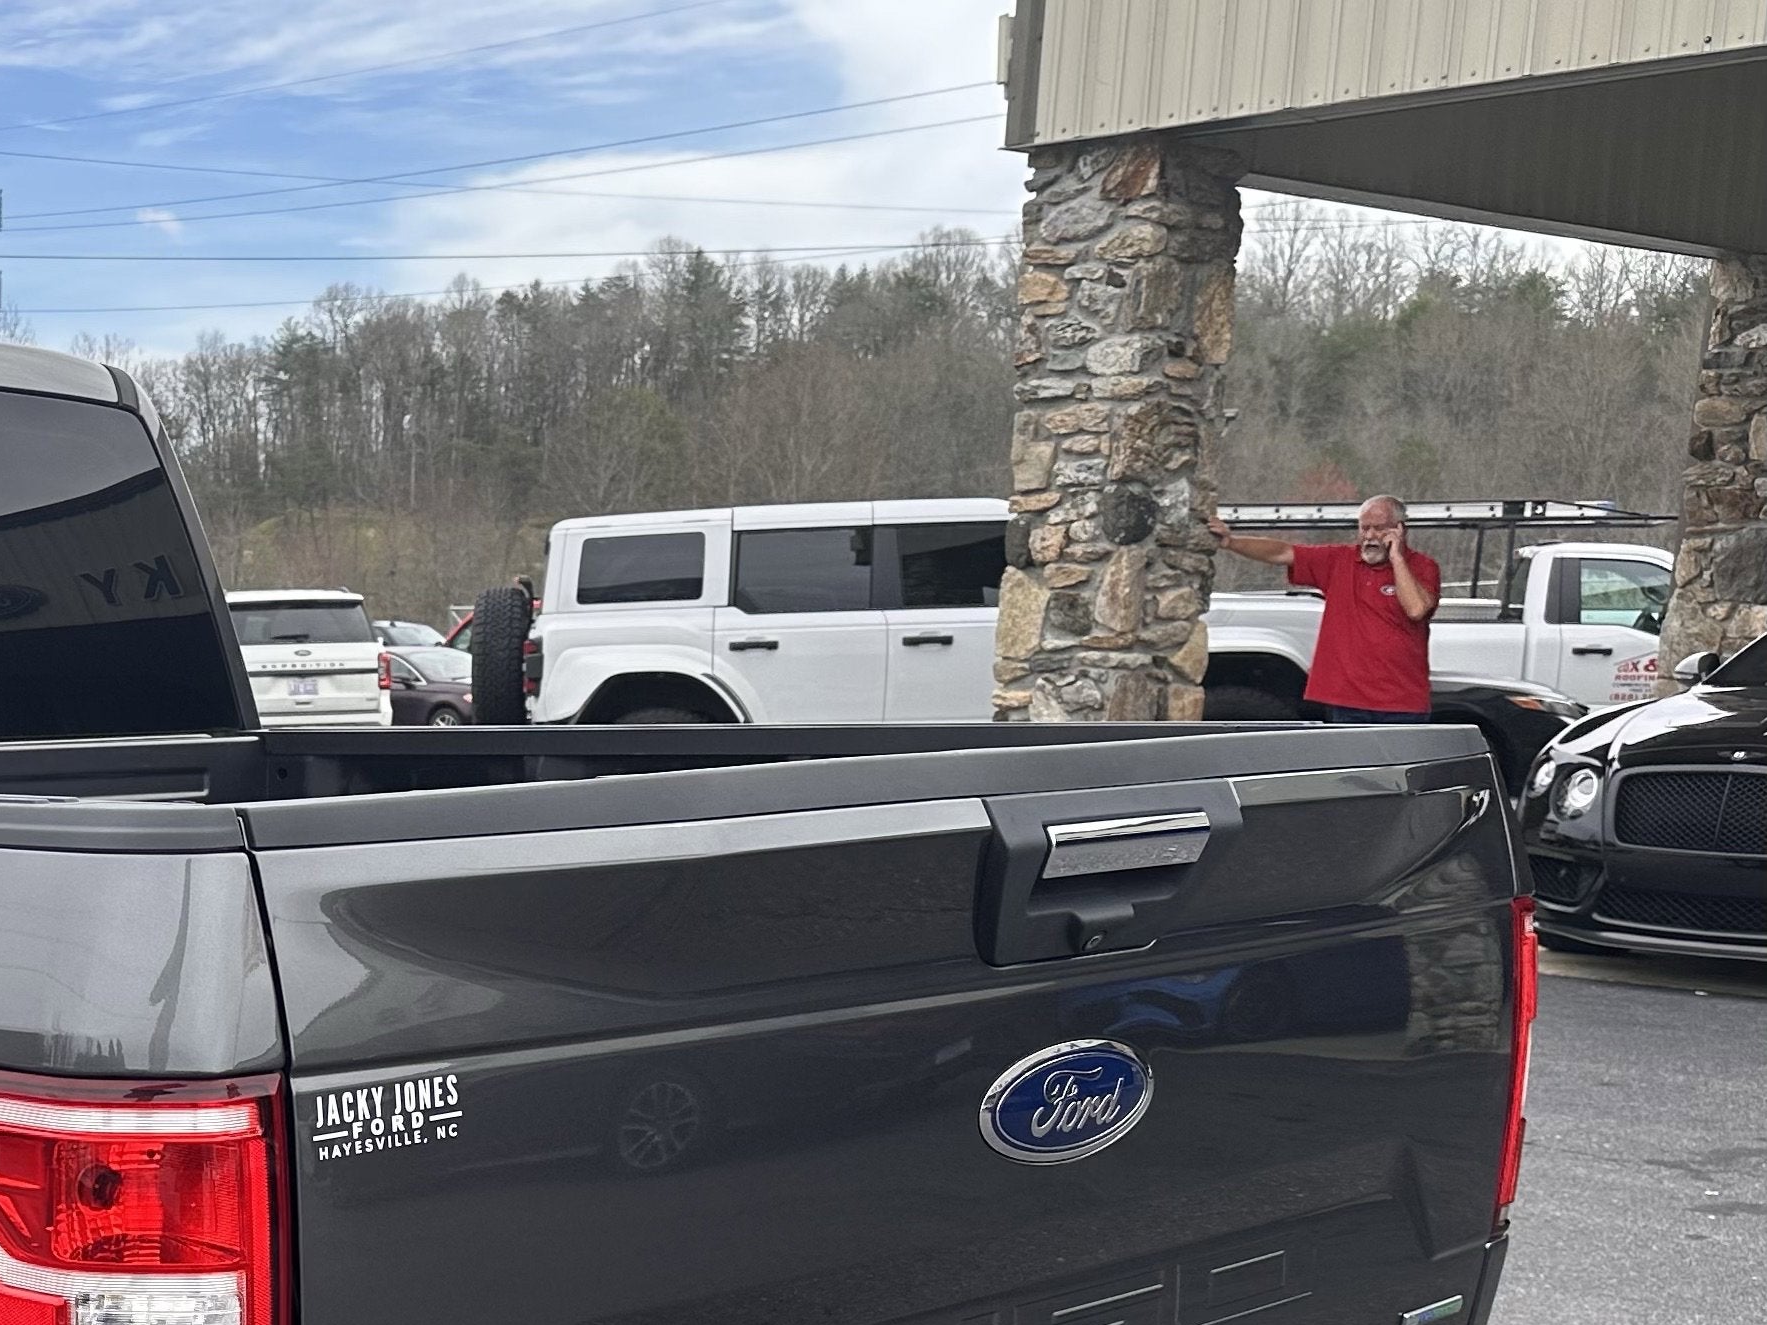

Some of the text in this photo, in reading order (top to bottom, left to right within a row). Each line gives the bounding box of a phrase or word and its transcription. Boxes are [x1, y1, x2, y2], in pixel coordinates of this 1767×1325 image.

[315, 1074, 459, 1128] JACKY JONES
[1031, 1066, 1125, 1138] Ford
[318, 1123, 458, 1160] HAYESVILLE, NC
[351, 1111, 425, 1139] FORD
